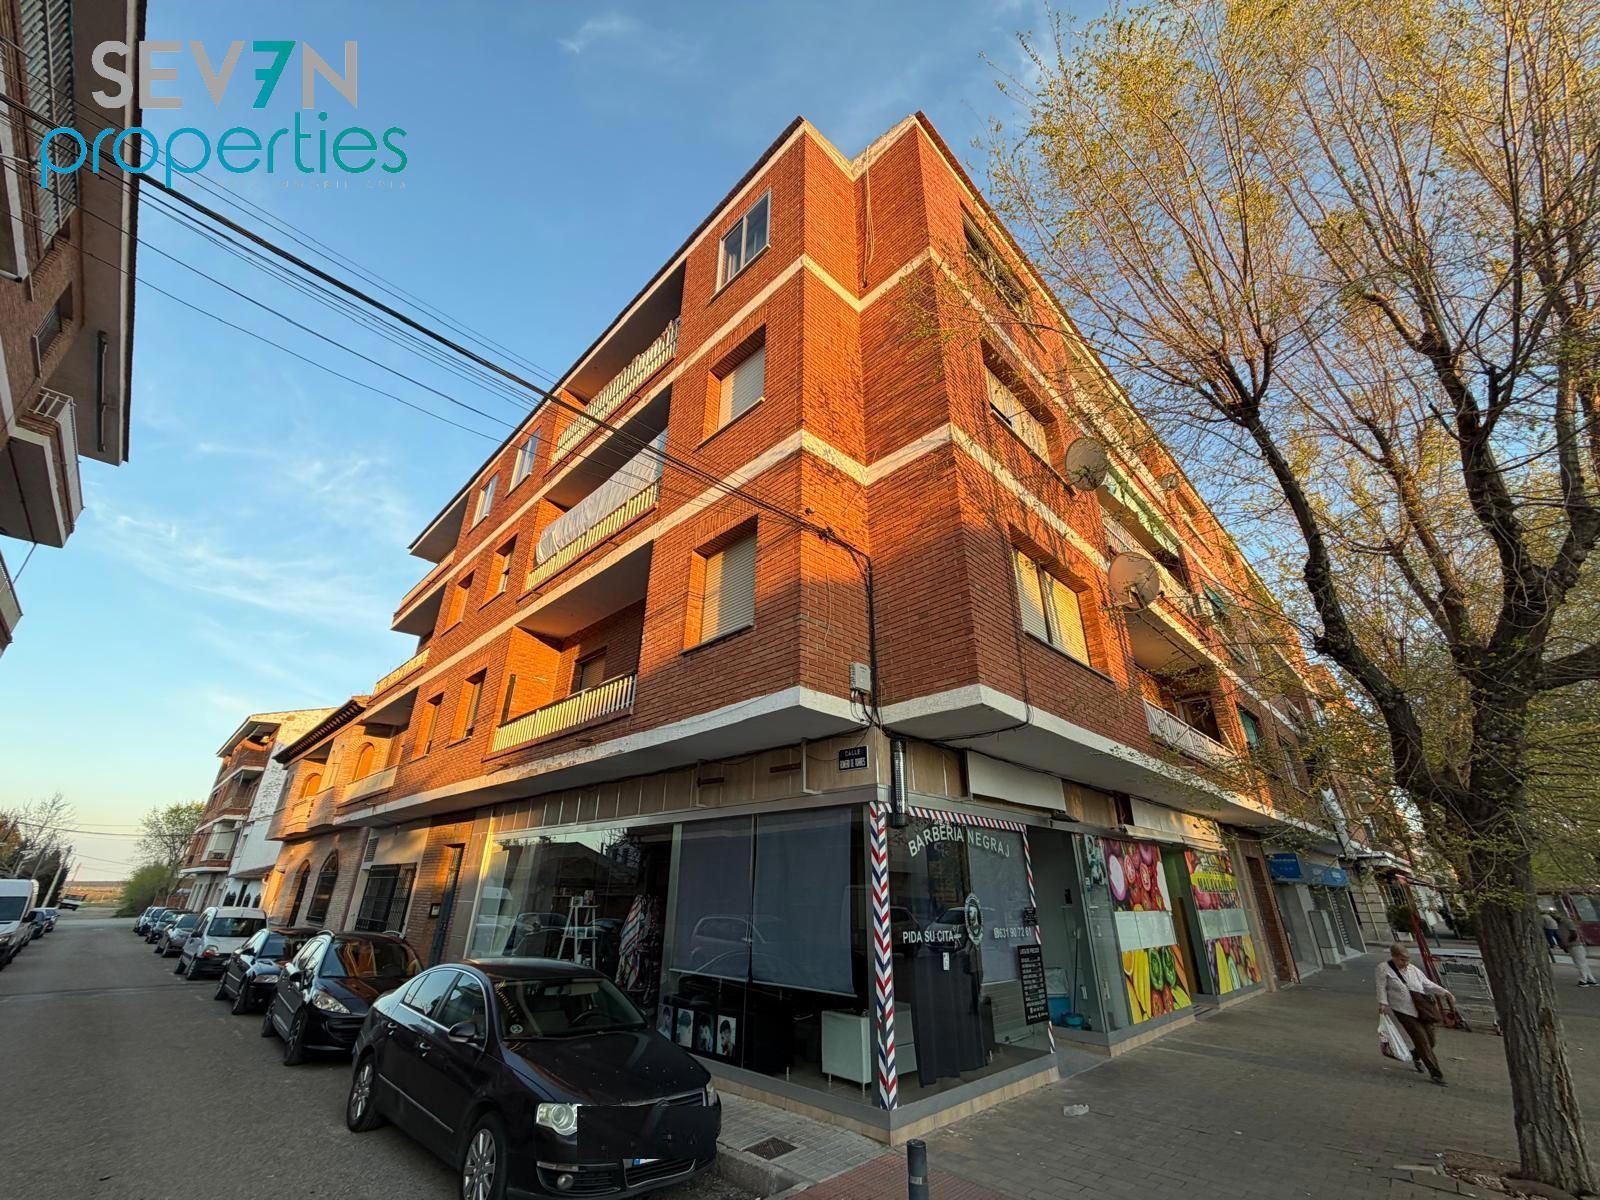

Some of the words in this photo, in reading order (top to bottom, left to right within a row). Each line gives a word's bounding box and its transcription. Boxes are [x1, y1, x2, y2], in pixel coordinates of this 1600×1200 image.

[844, 748, 861, 757] CALLE
[902, 931, 921, 944] PIDA
[924, 930, 935, 942] SU
[937, 930, 954, 942] CITA
